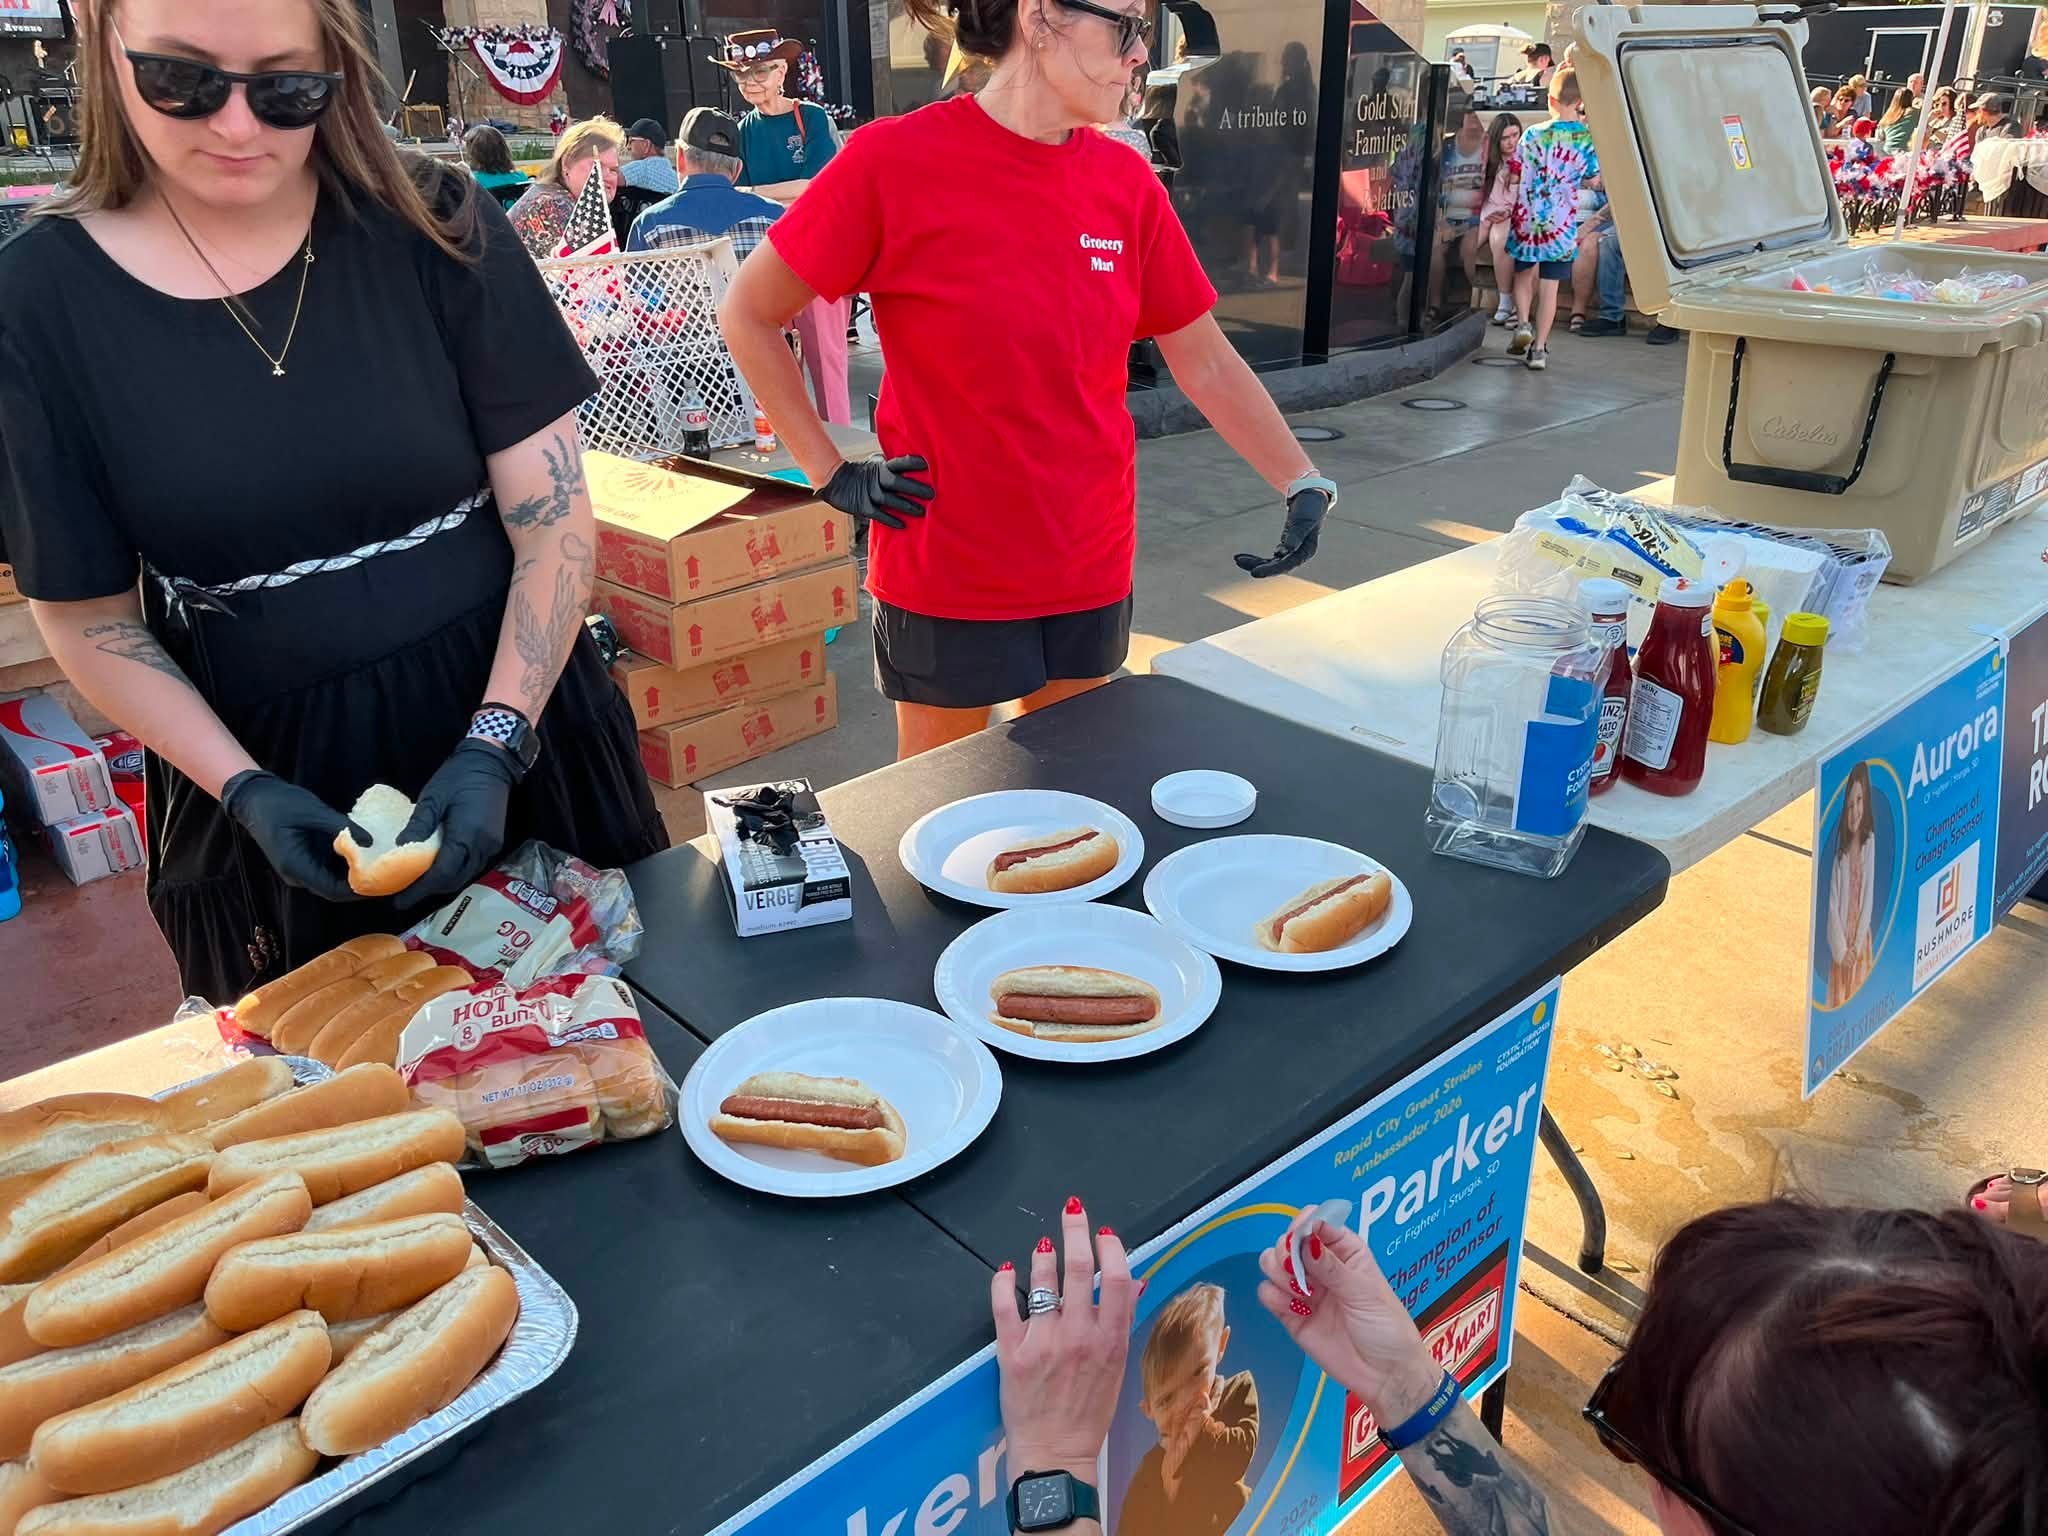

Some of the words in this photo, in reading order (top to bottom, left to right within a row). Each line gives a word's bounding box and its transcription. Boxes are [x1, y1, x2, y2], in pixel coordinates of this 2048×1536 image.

[4, 22, 43, 32] Avenue
[1219, 107, 1232, 129] A
[1237, 105, 1288, 128] tribute
[1293, 106, 1308, 126] to
[1357, 92, 1388, 122] Gold
[1354, 126, 1408, 156] Families
[1361, 184, 1415, 214] Relatives
[1080, 233, 1124, 255] Grocery
[1090, 256, 1115, 273] Mart
[686, 412, 709, 425] Cok
[1641, 682, 1658, 697] HEINZ
[1602, 704, 1621, 717] INZ
[1906, 704, 1998, 800] Aurora
[1925, 802, 1968, 843] Champion
[1970, 791, 1980, 811] of
[1915, 837, 1949, 872] Change
[1950, 808, 1984, 846] Sponsor
[743, 886, 798, 911] VERGE
[1917, 904, 1974, 964] RUSHMORE
[453, 995, 512, 1026] HOT
[463, 1026, 473, 1040] 8
[1496, 1036, 1541, 1075] FOUNDATION
[1497, 1040, 1521, 1064] CYSTIC
[482, 1092, 499, 1103] NET
[501, 1087, 514, 1098] WT
[529, 1081, 543, 1092] OZ
[1334, 1128, 1373, 1168] Rapid
[1376, 1114, 1402, 1139] City
[1405, 1088, 1440, 1120] Great
[1443, 1059, 1484, 1094] Strides
[1352, 1120, 1430, 1182] Ambassador
[1432, 1095, 1463, 1125] 2026
[1358, 1081, 1537, 1244] Parker
[1386, 1235, 1403, 1256] CF
[1404, 1207, 1441, 1243] Fighter
[1486, 1159, 1501, 1179] SD
[1477, 1191, 1496, 1222] of
[1401, 1278, 1430, 1312] nge
[1436, 1216, 1503, 1282] Sponsor
[1453, 1298, 1496, 1363] MART
